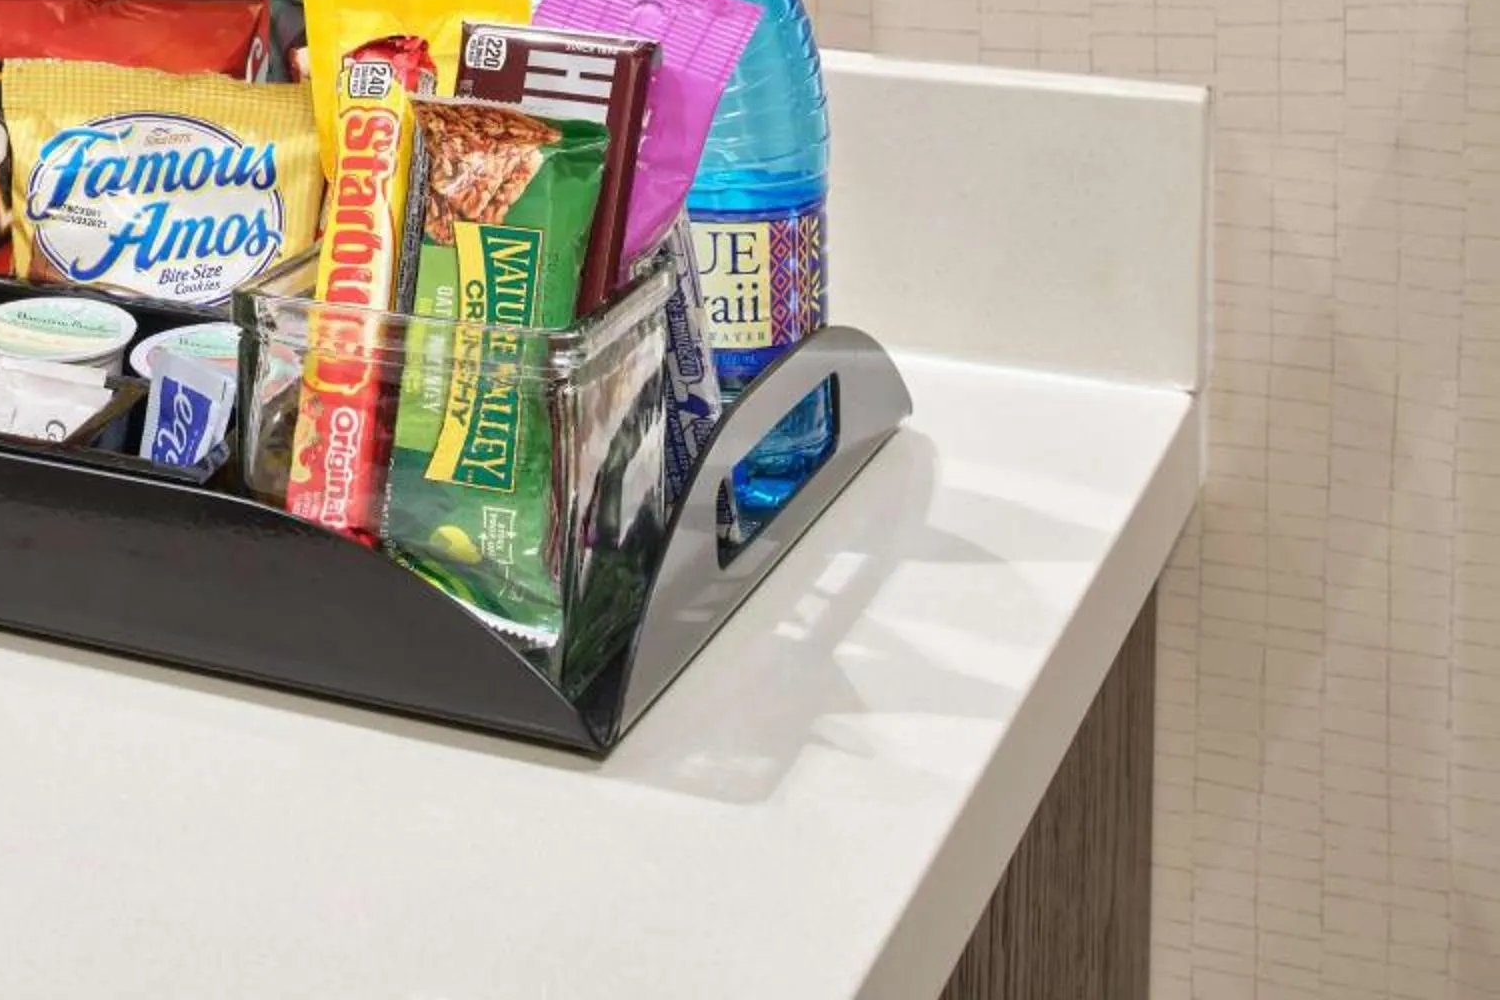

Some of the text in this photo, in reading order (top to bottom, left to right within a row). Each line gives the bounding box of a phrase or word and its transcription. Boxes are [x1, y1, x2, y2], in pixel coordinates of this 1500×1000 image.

[483, 38, 504, 68] 220
[367, 66, 388, 95] 240
[26, 124, 277, 220] Famous
[70, 201, 282, 281] Amos
[158, 263, 223, 286] Bite Size
[174, 280, 221, 296] Cookies
[704, 282, 765, 323] aii
[321, 404, 363, 530] Original
